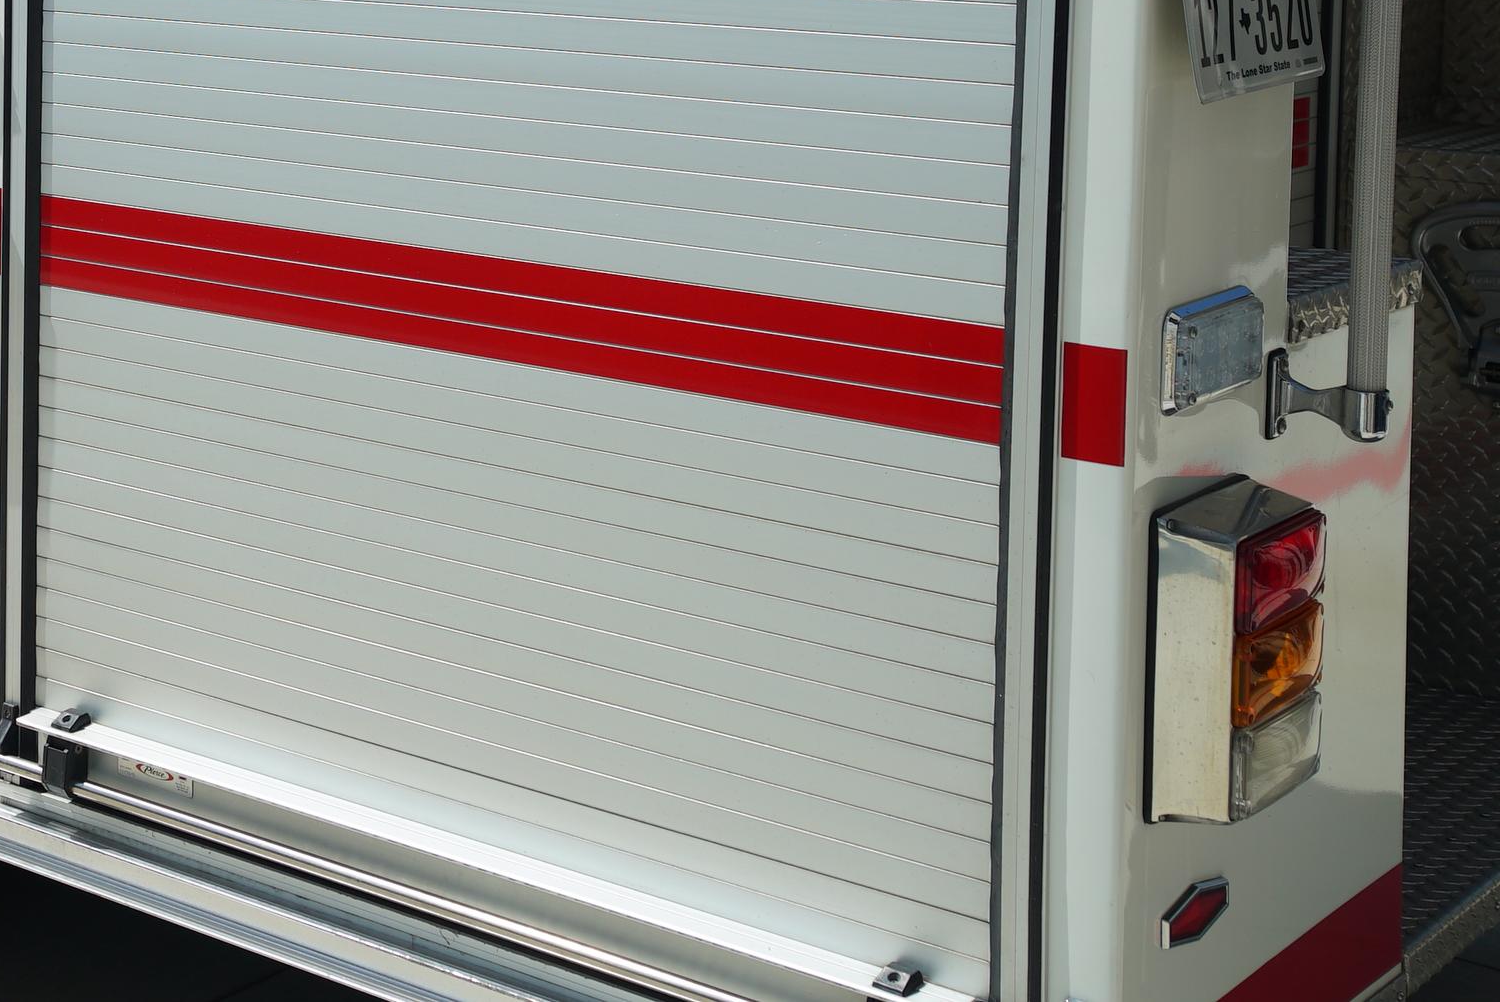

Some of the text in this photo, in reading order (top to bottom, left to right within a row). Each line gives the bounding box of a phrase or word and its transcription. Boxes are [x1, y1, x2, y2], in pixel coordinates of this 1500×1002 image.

[1226, 59, 1291, 82] The Lone Star State
